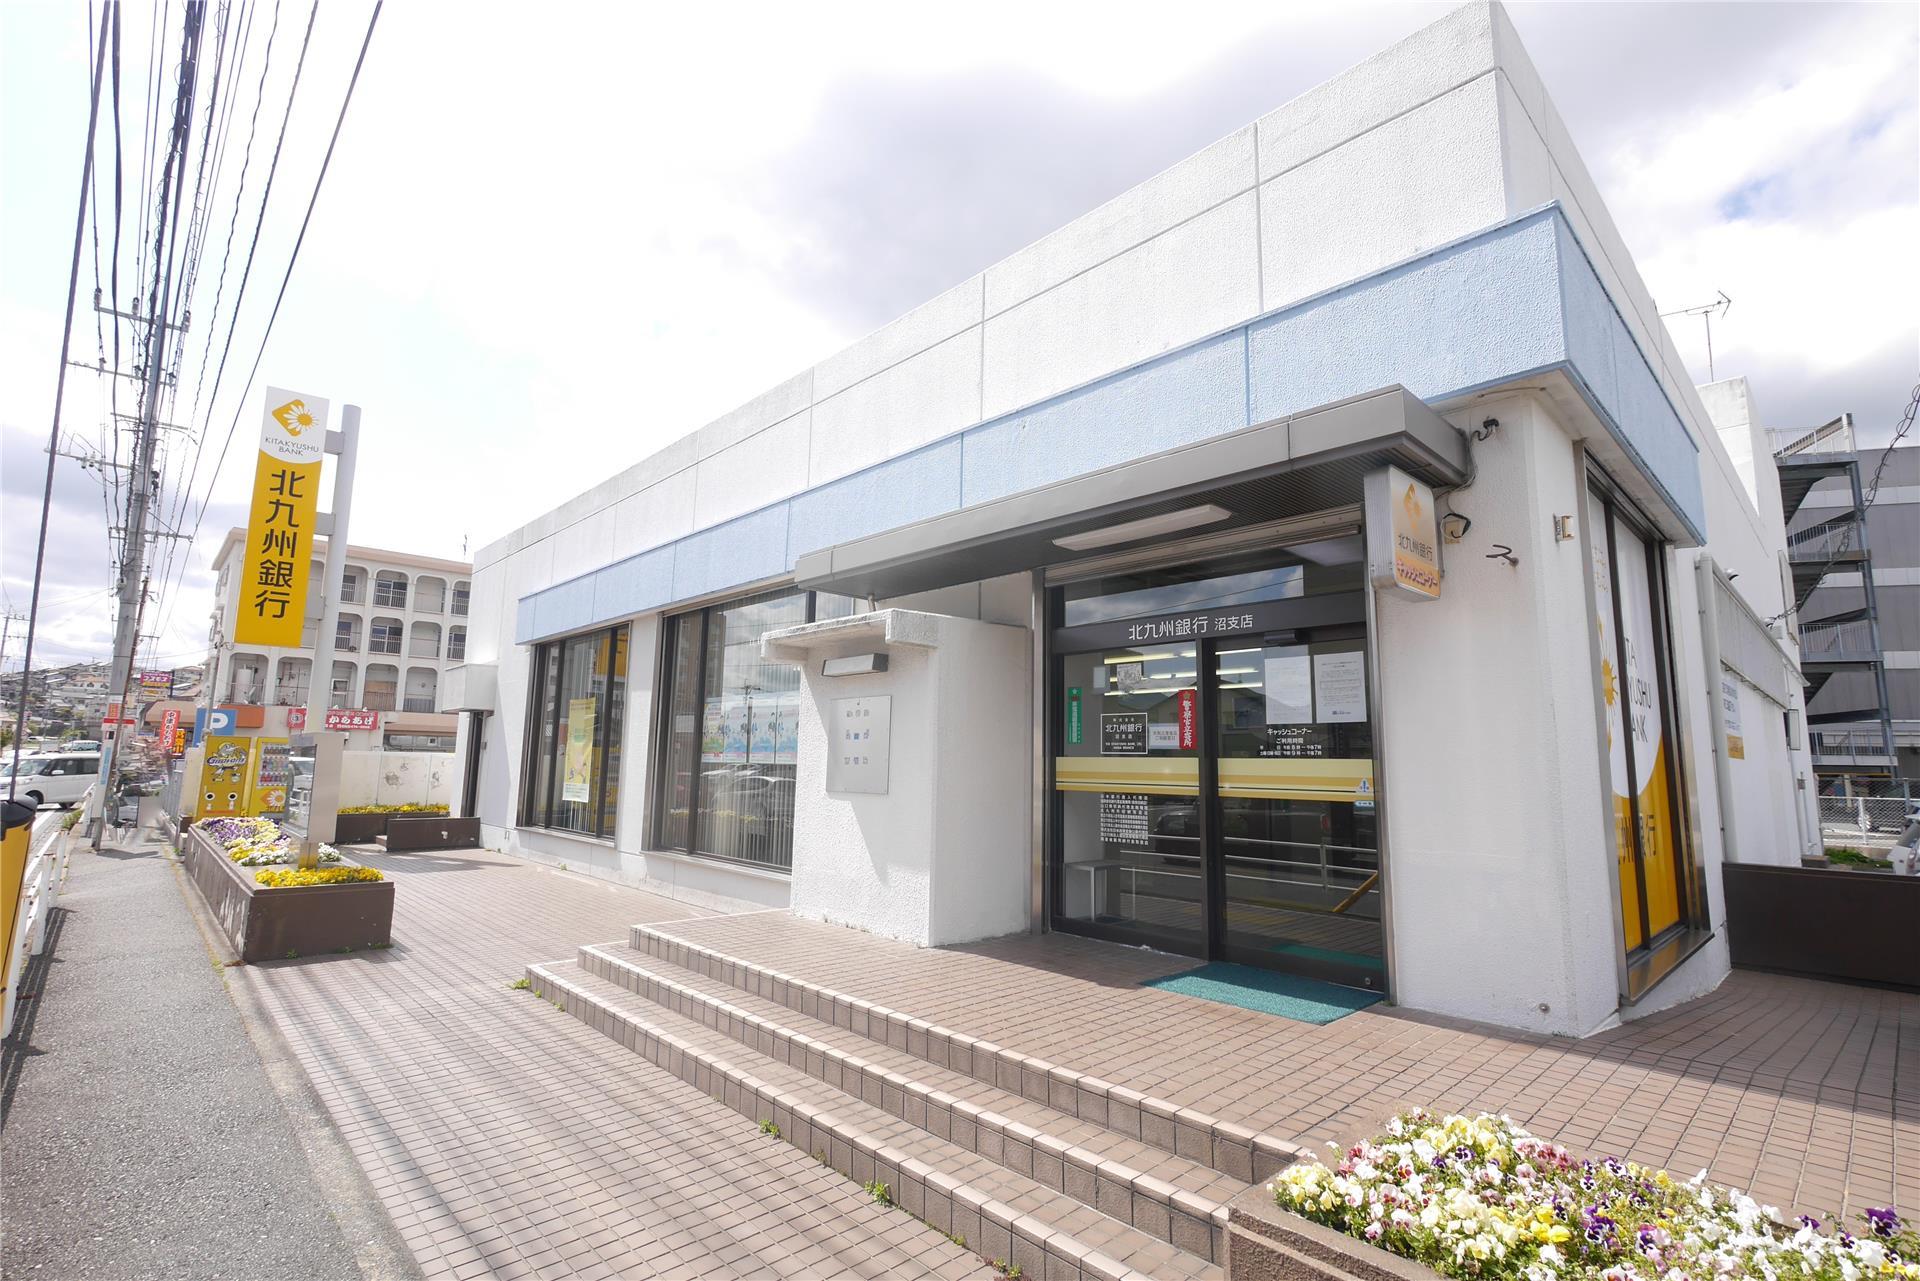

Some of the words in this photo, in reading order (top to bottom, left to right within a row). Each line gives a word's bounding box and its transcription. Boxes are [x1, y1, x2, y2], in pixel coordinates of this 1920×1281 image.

[265, 436, 319, 453] KITAKYUSHU
[279, 446, 304, 456] BANK
[254, 469, 305, 618] 北九州銀行
[1398, 534, 1433, 561] 北九州銀行
[1128, 616, 1209, 640] 北九州銀行
[1214, 614, 1253, 631] 沼支店
[1628, 674, 1652, 708] YUSHU
[210, 712, 229, 729] P
[328, 715, 374, 726] からあげ
[1105, 723, 1143, 733] 北九州銀行
[1267, 727, 1312, 736] キャッシュコーナー
